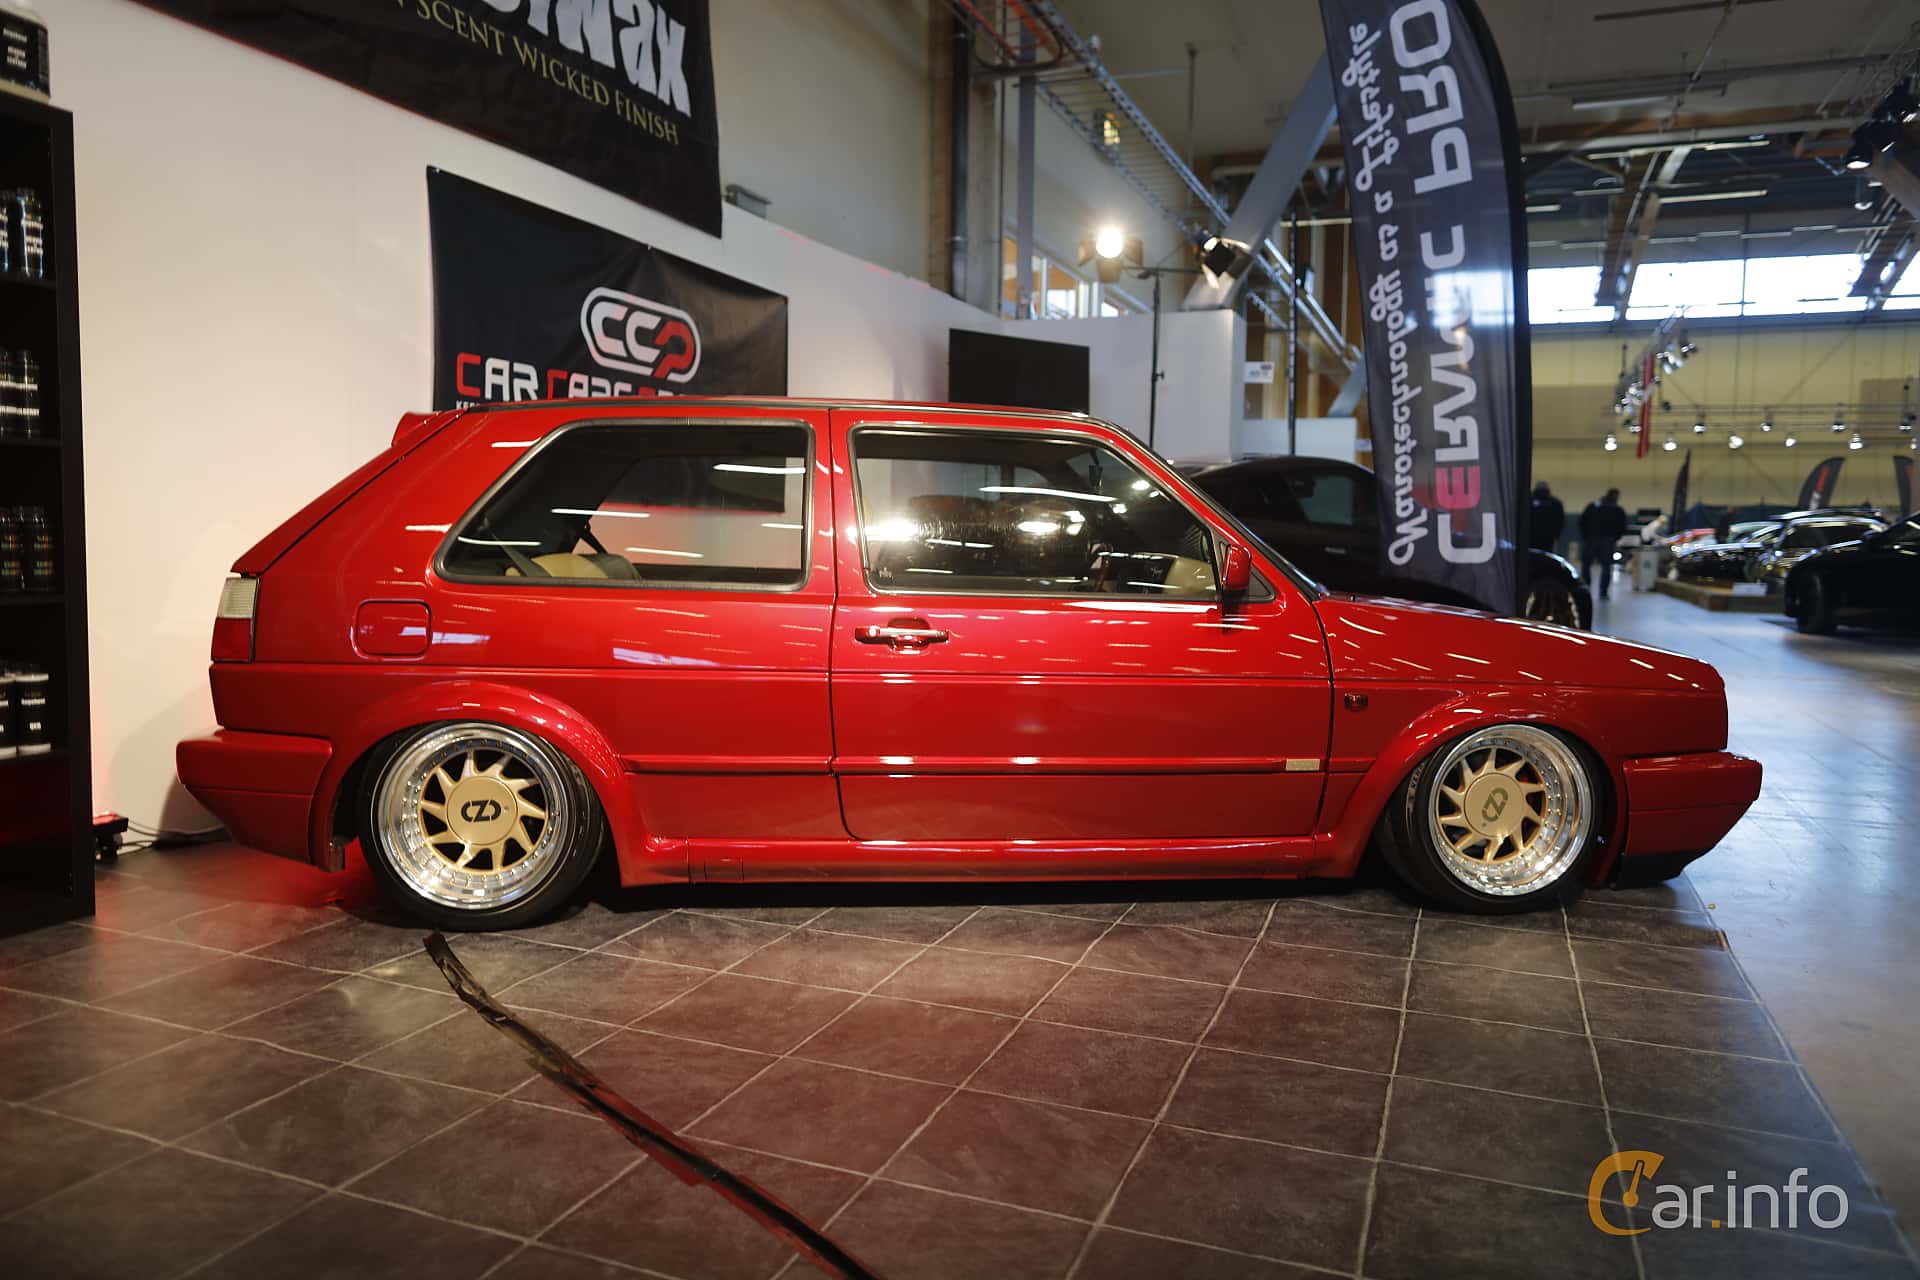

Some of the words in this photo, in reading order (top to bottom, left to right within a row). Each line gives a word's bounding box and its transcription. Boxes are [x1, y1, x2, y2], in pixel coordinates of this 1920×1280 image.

[416, 0, 505, 56] SCENT
[513, 35, 610, 107] WICKED
[614, 89, 680, 145] FINISH
[456, 351, 539, 402] CAR
